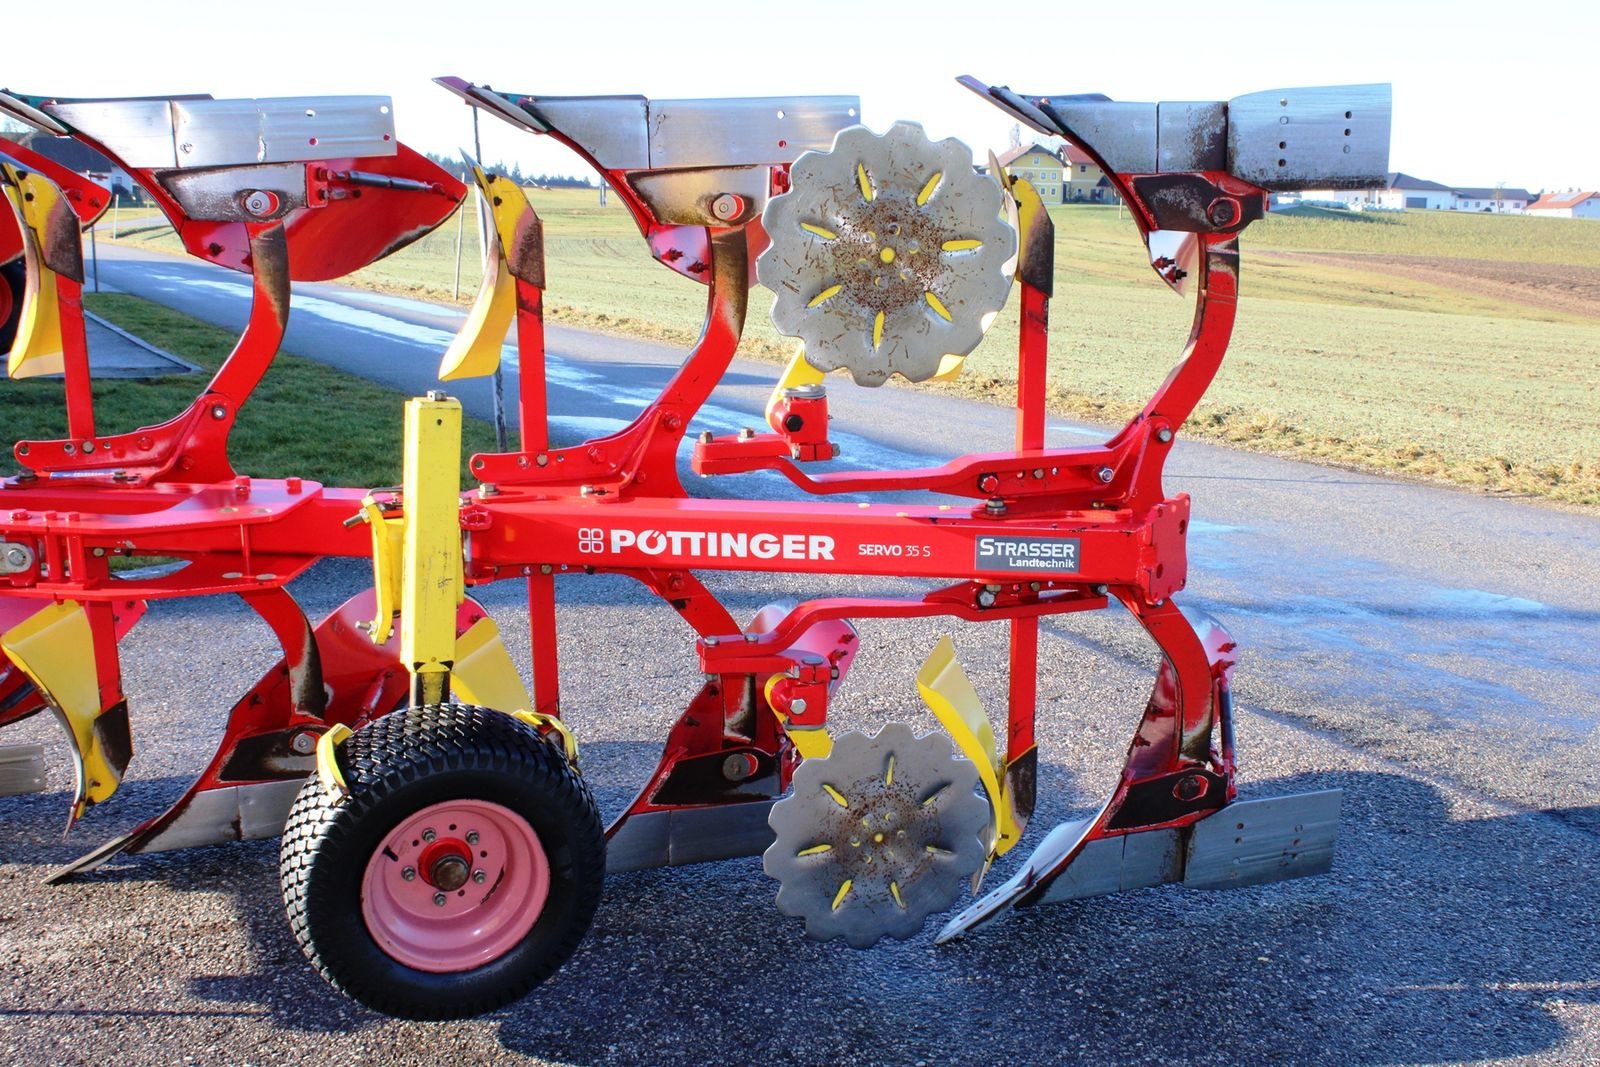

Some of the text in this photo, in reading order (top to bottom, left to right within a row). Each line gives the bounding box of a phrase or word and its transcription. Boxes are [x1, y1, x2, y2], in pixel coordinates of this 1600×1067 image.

[610, 529, 835, 561] PÖTTINGER
[858, 543, 931, 558] SERVO 35 S
[980, 538, 1075, 558] STRASSER
[1009, 557, 1075, 569] Landtechnik
